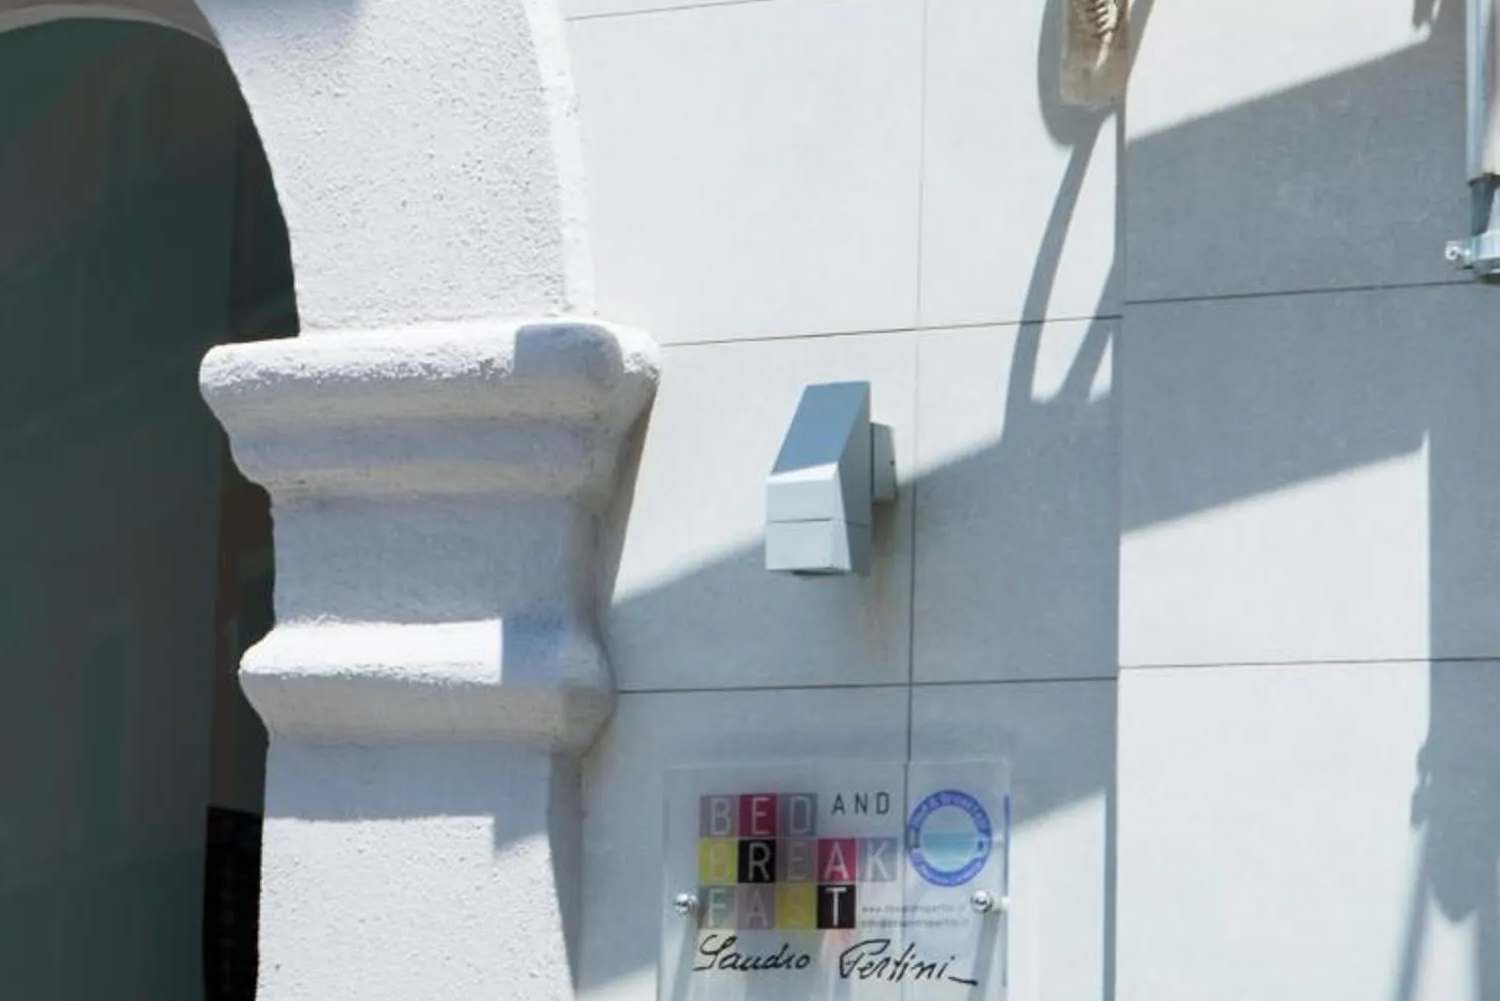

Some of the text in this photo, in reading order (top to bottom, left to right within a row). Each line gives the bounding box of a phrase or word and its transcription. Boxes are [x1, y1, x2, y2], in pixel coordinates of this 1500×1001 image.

[709, 791, 892, 837] BED AND
[709, 839, 891, 882] BREAK
[692, 934, 812, 972] Sandro
